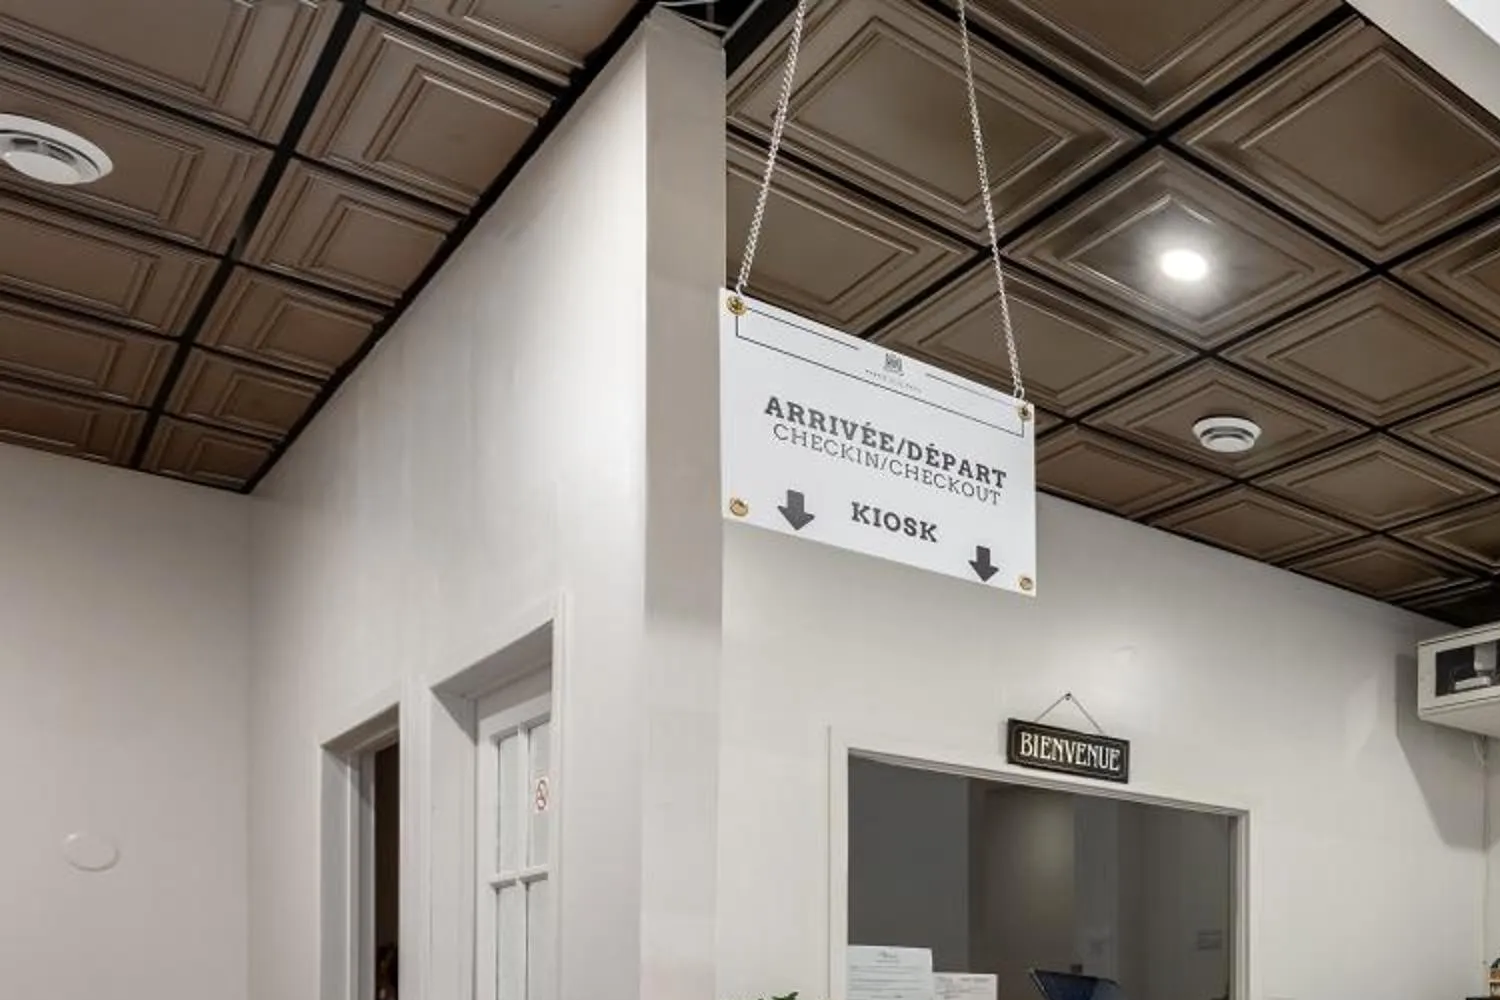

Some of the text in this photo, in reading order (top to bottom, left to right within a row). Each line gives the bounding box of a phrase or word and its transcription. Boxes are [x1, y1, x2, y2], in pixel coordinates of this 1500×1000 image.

[764, 396, 1006, 488] ARRIVÉE/DÉPART
[773, 423, 1001, 506] CHECKIN/CHECKOUT
[851, 501, 938, 543] KIOSK
[1020, 731, 1120, 771] BIENVENUE
